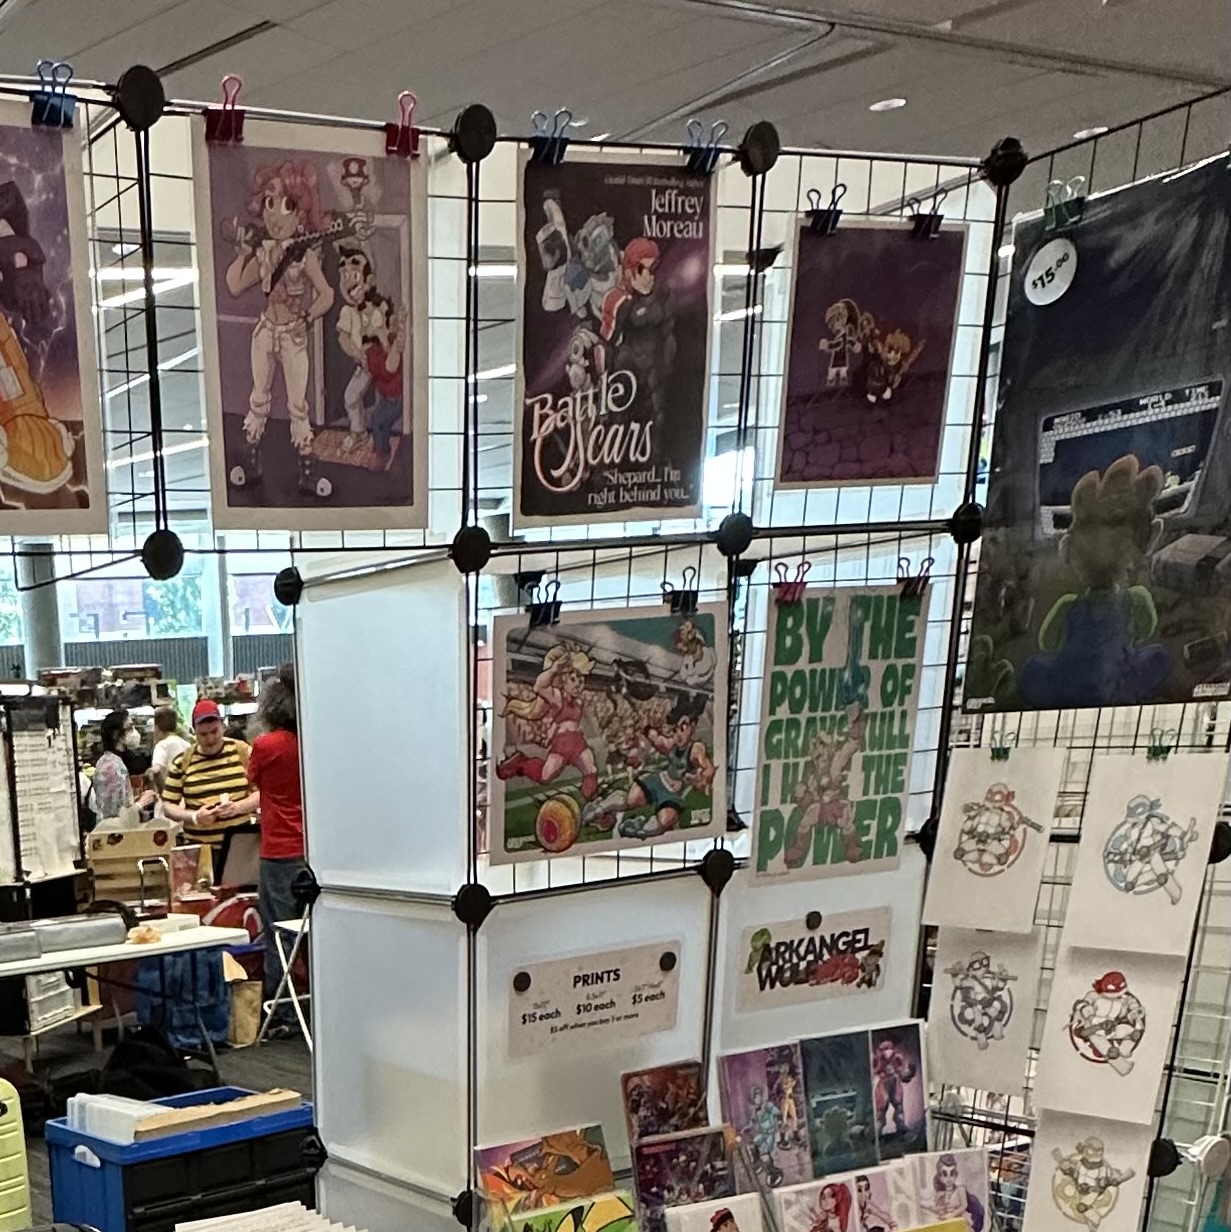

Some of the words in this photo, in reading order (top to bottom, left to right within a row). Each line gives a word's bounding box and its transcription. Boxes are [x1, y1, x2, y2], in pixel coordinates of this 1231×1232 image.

[651, 188, 704, 221] Jeffrey
[643, 214, 704, 239] Moreau
[525, 369, 637, 441] Battle
[619, 484, 661, 503] behind
[773, 597, 835, 666] BY
[769, 663, 871, 716] POWR
[880, 662, 916, 709] OF
[764, 708, 910, 761] GRAYSULL
[862, 751, 907, 796] THE
[759, 927, 875, 968] ARKANGEL
[572, 968, 621, 989] PRINTS
[576, 1003, 593, 1015] $10
[593, 1000, 616, 1012] each
[632, 993, 643, 1006] $5
[644, 990, 665, 1003] each
[521, 1011, 537, 1025] $15
[538, 1009, 561, 1022] each
